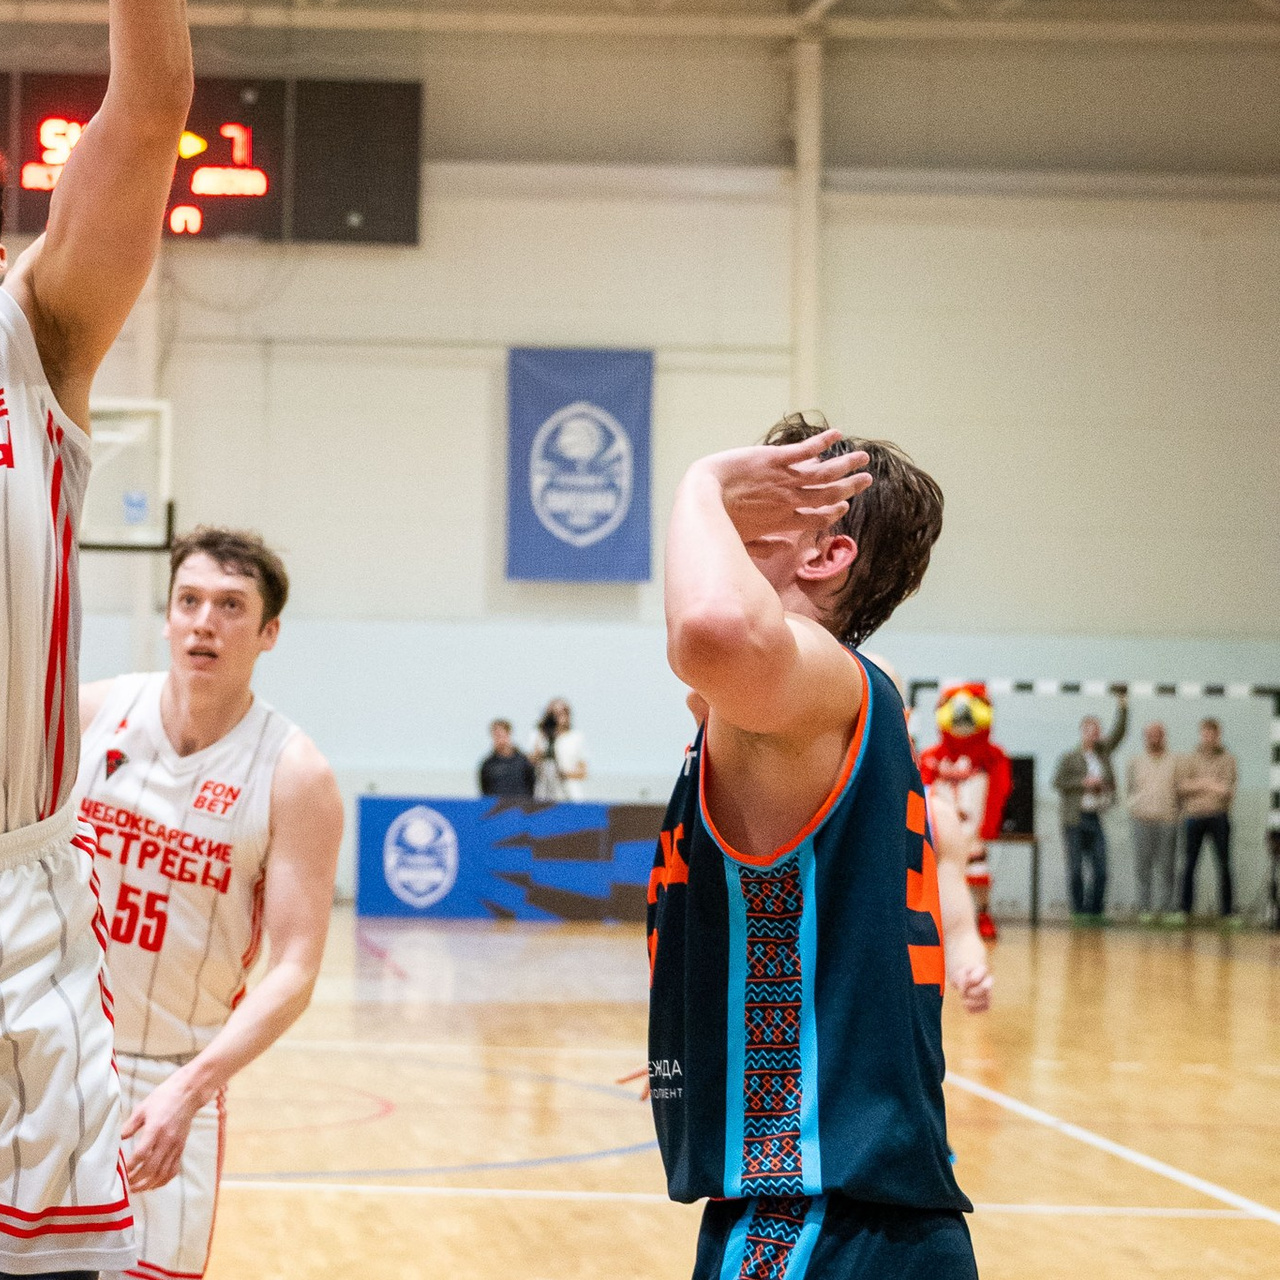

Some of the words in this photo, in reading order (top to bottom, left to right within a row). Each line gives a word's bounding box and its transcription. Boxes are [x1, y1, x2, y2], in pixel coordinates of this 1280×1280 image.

[193, 794, 235, 816] BET
[199, 779, 241, 802] FON
[80, 798, 233, 862] ЧЕБОКСАРСКИЕ
[95, 826, 232, 893] СТРЕБЫ
[110, 882, 170, 953] 55
